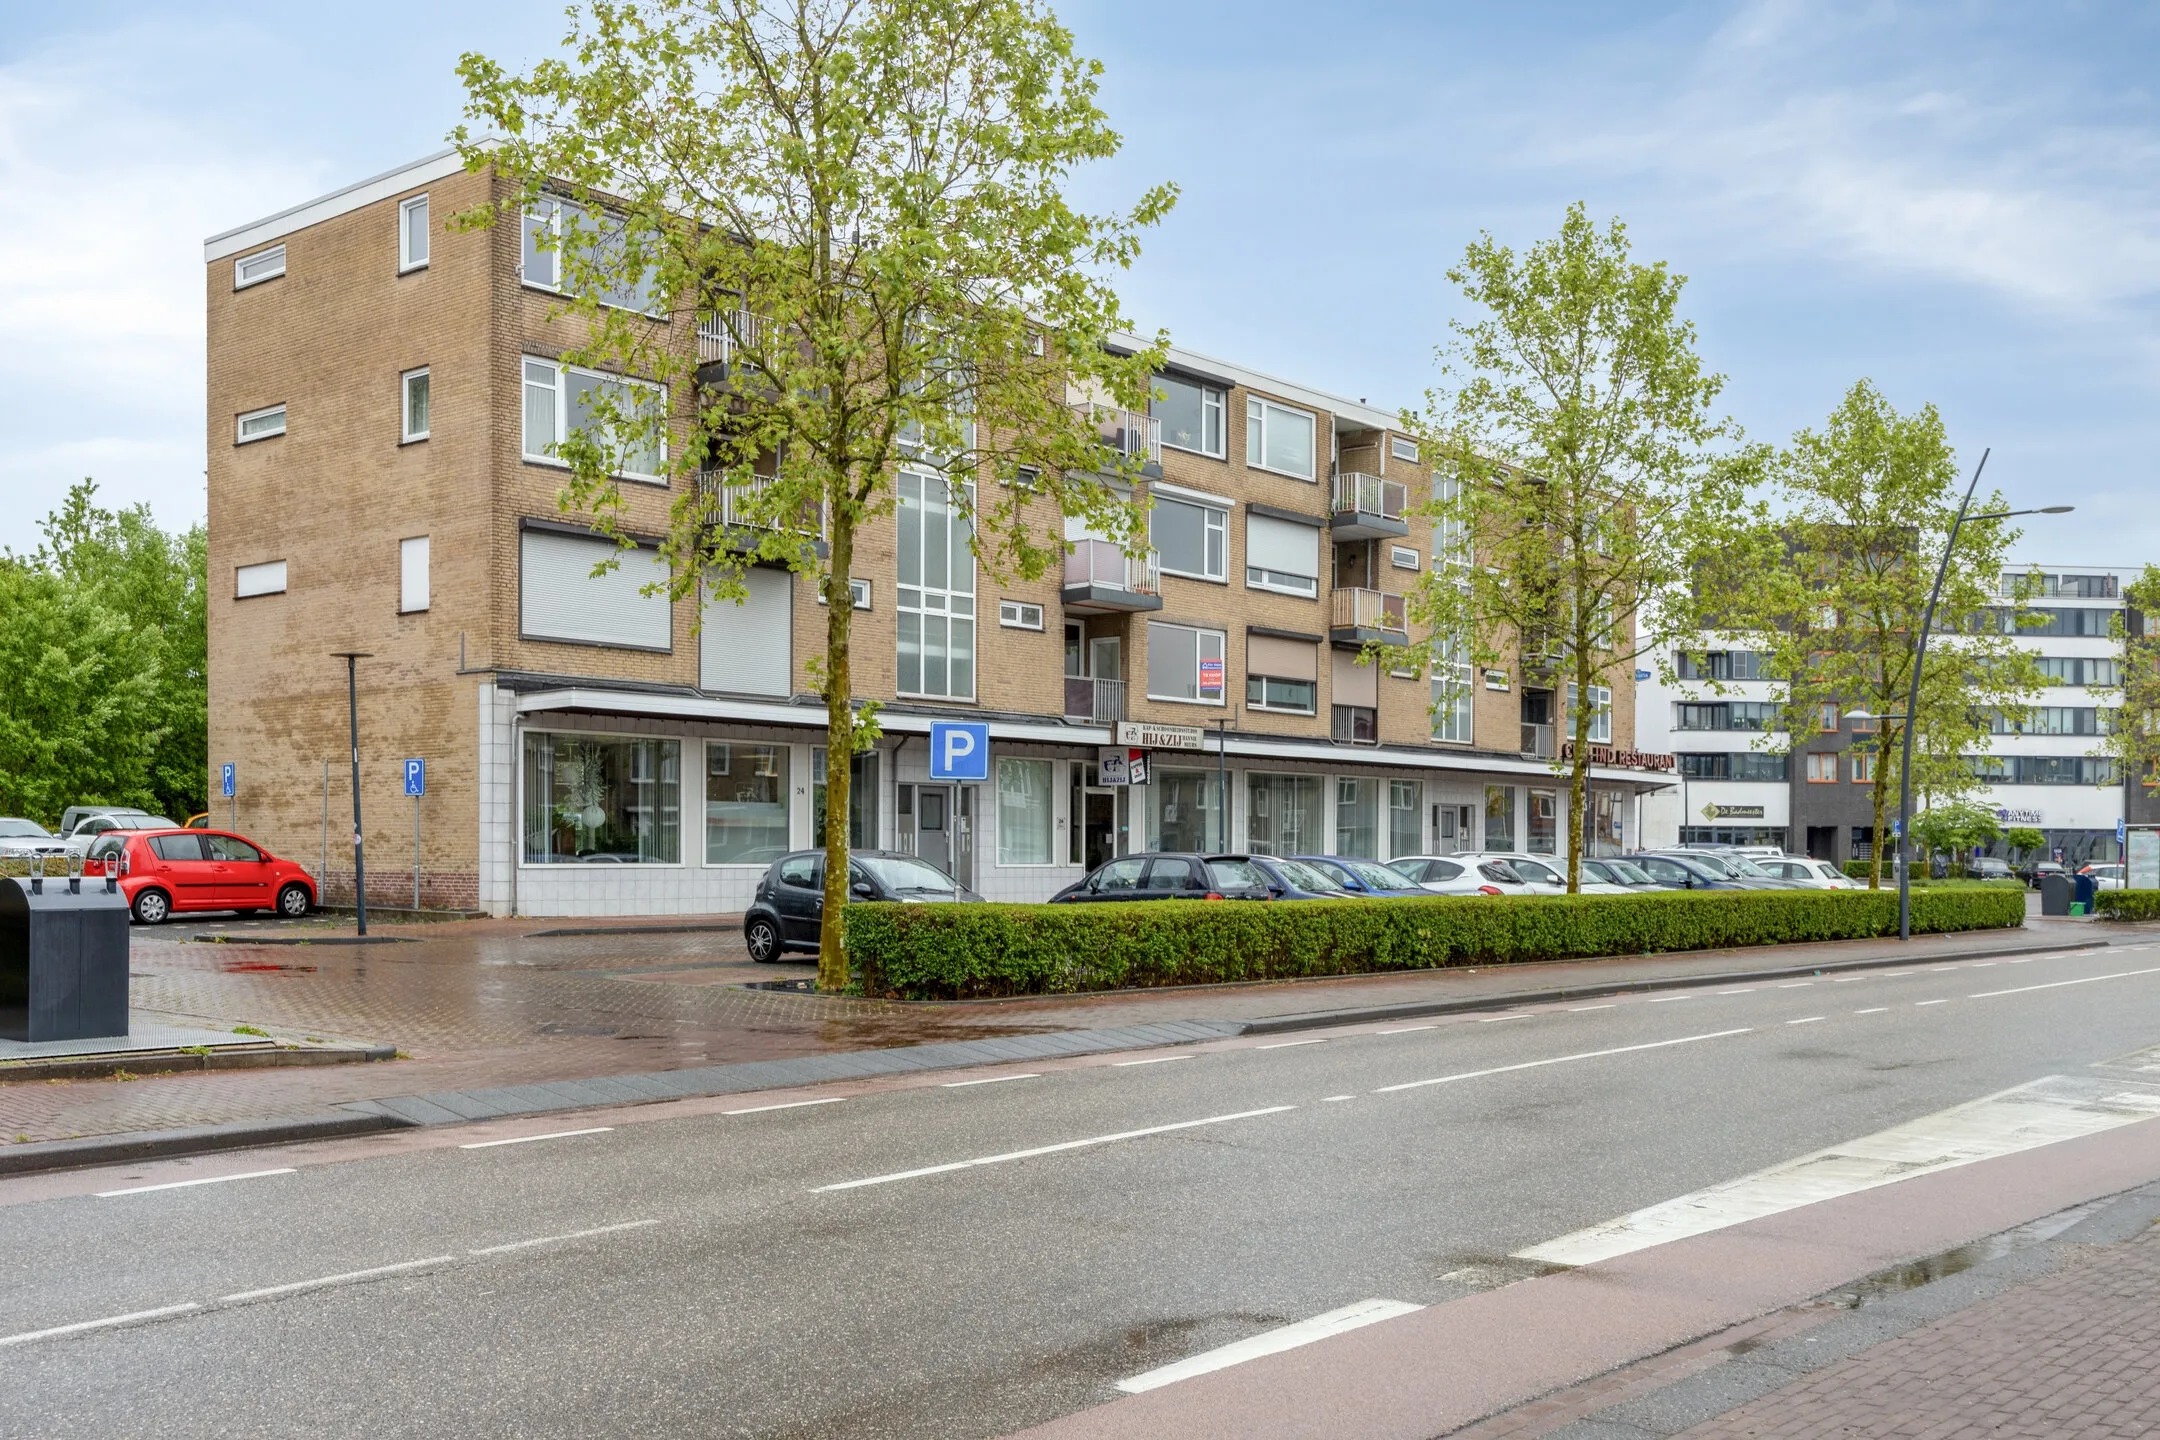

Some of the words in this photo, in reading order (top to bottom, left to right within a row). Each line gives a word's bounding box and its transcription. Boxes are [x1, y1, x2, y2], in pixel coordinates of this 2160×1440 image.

[945, 730, 975, 771] P
[225, 766, 232, 783] P
[409, 762, 420, 780] P
[797, 787, 805, 795] 24
